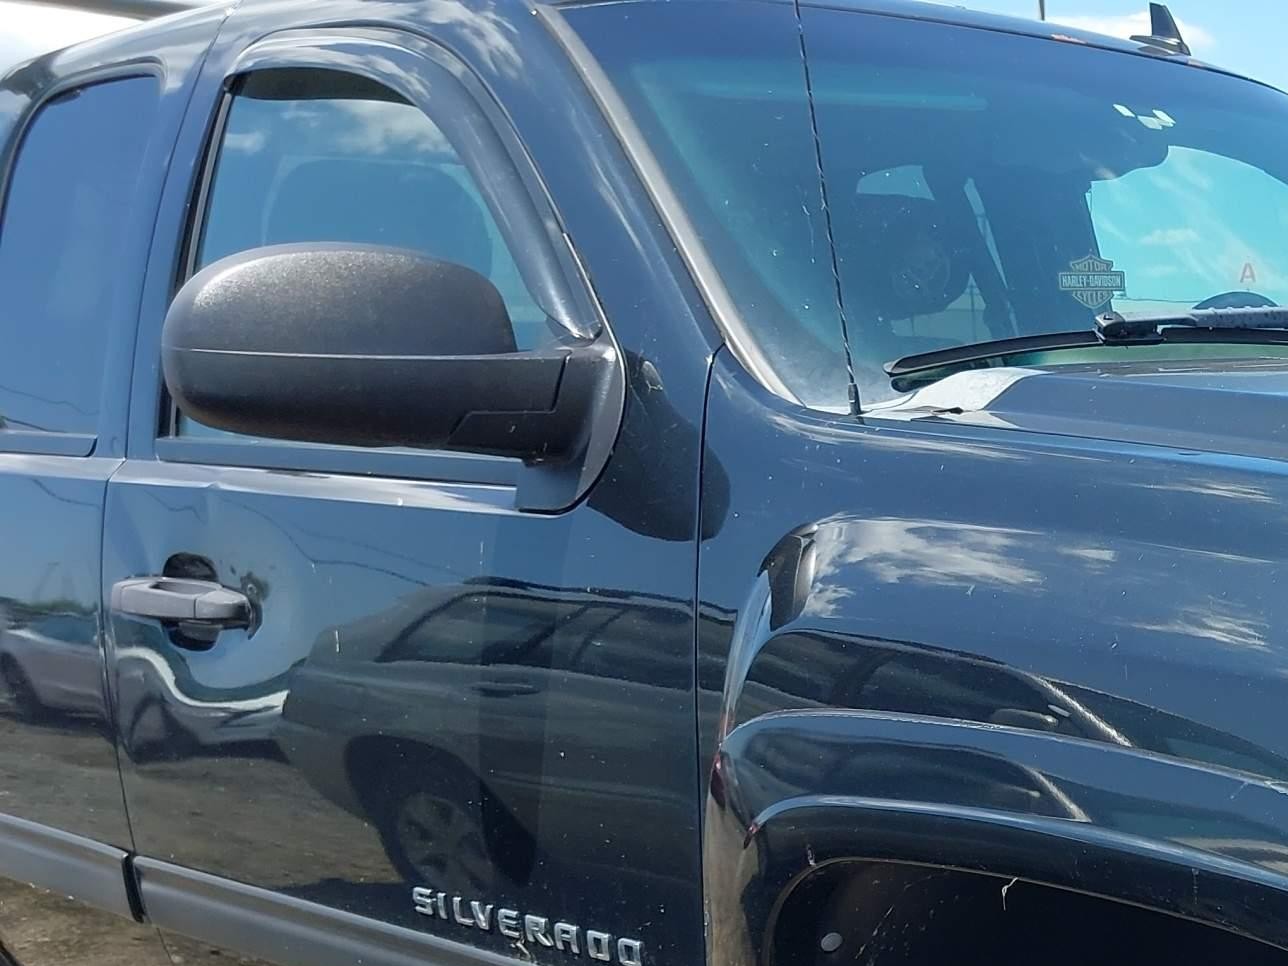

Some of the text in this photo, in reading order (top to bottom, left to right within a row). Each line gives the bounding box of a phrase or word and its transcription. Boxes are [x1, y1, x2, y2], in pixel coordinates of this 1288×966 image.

[1071, 259, 1109, 272] MOTOR
[1239, 262, 1256, 283] A
[1062, 274, 1121, 288] HARLEY-DAVIDSON
[1075, 290, 1109, 305] CYCLES
